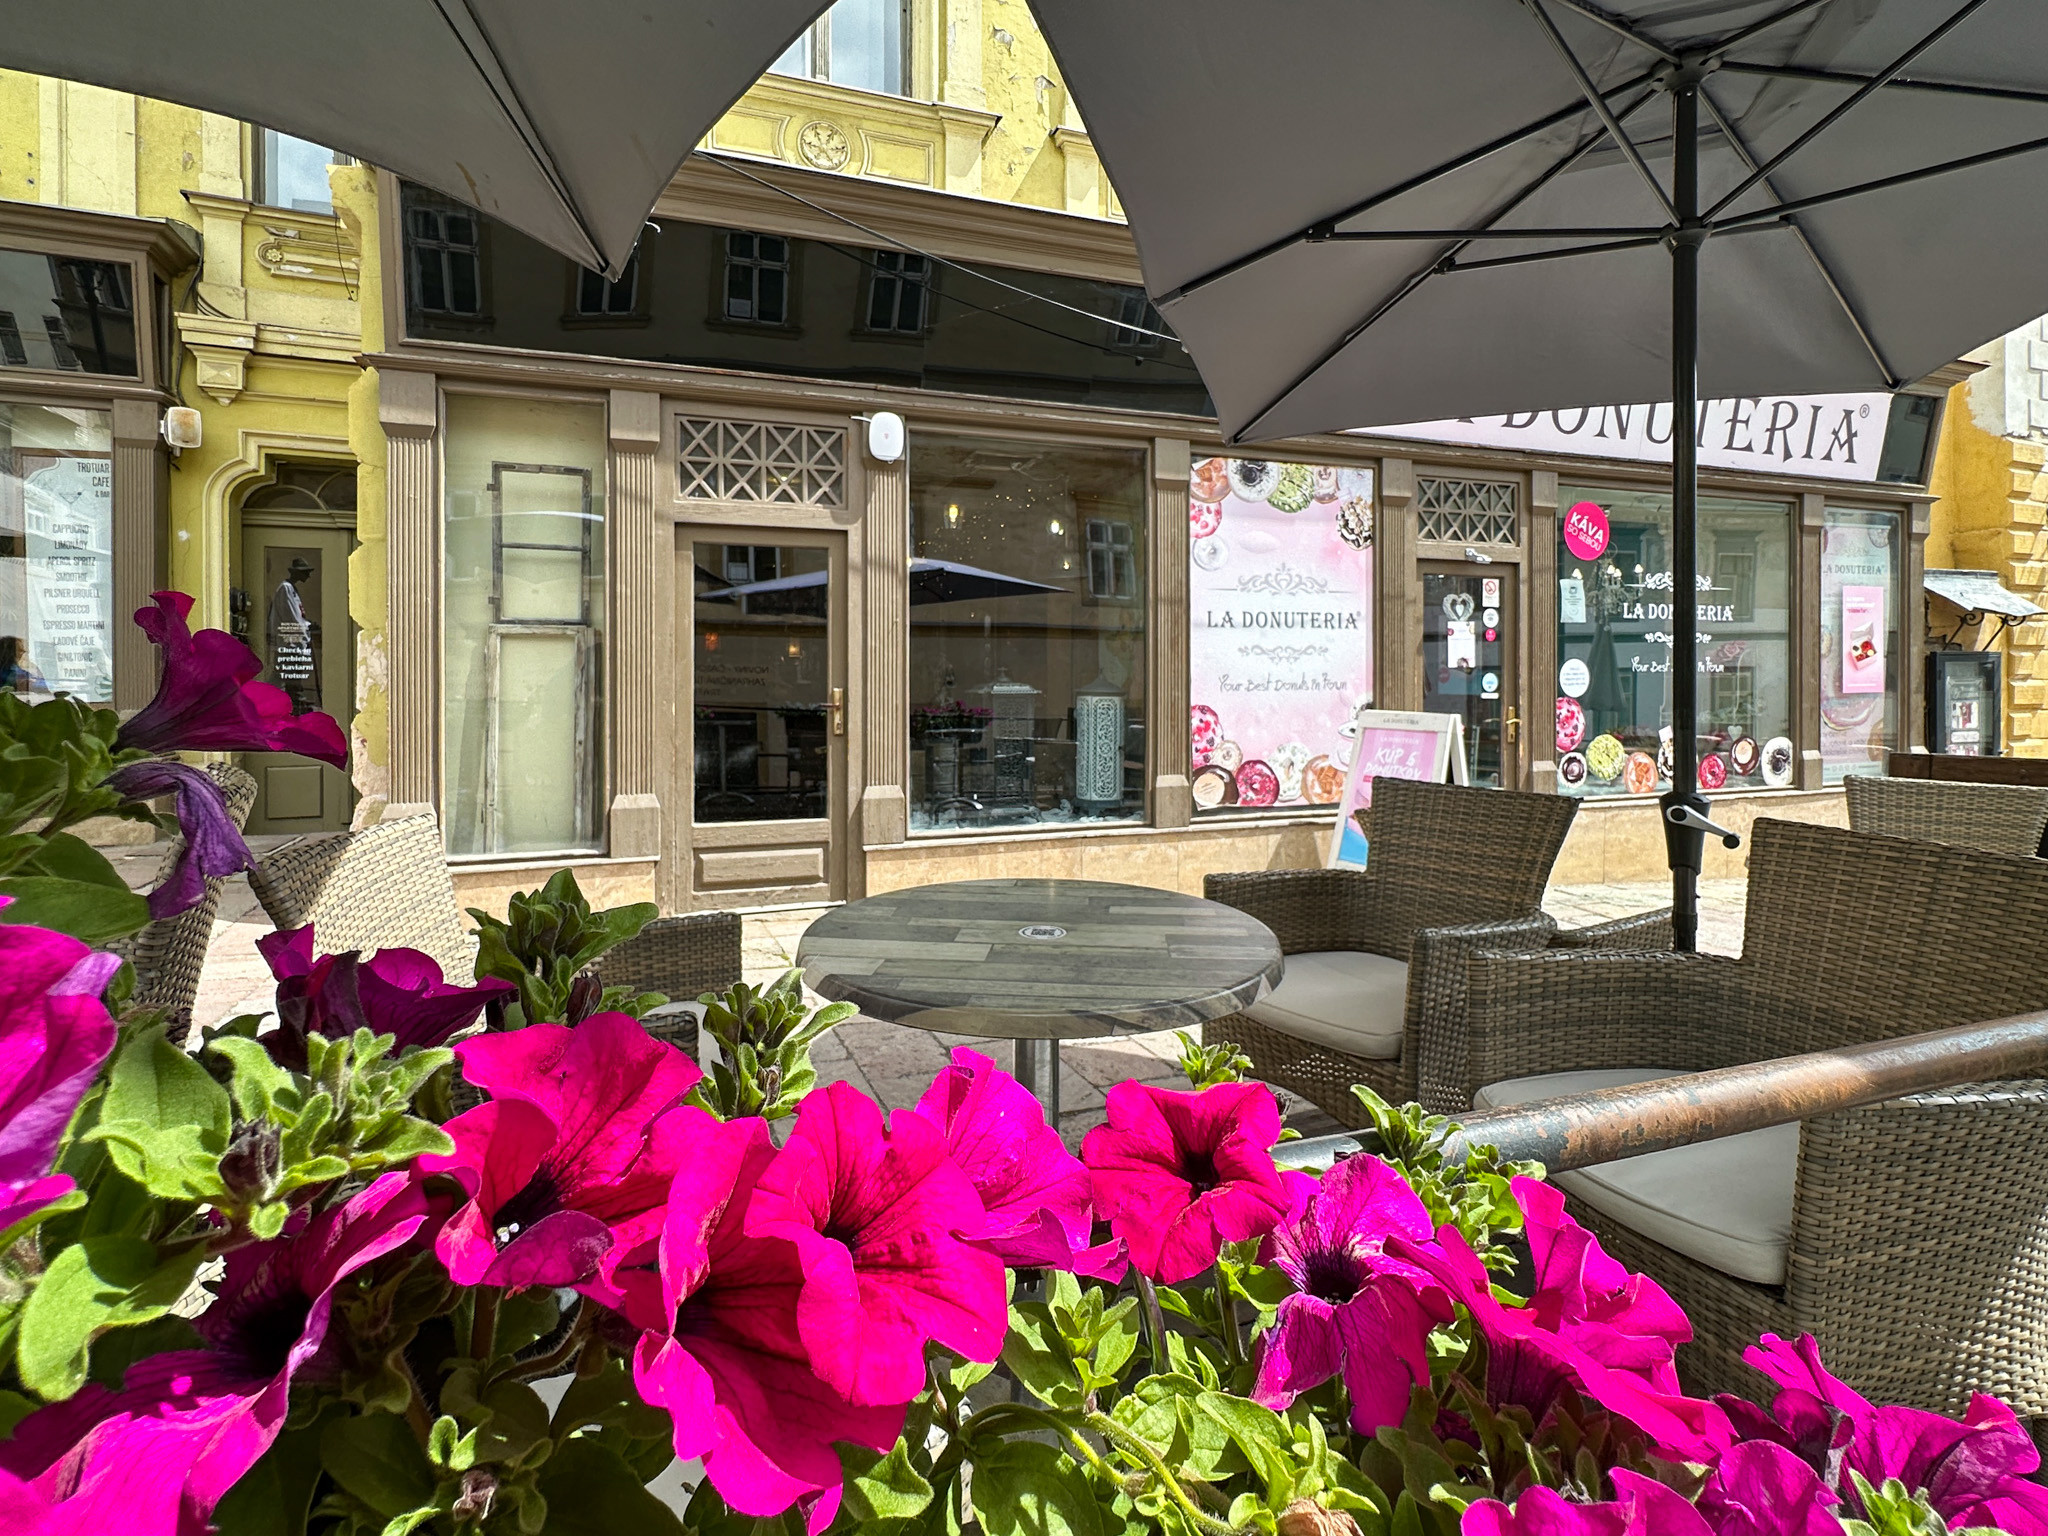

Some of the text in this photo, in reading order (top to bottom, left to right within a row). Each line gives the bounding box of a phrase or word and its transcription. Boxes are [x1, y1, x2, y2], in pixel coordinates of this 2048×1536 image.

[77, 462, 110, 473] TROTUAR
[92, 476, 110, 487] CAFE
[1570, 511, 1604, 543] KÁVA
[1567, 523, 1602, 551] SO SEBOU
[73, 556, 96, 567] SPRITZ
[1834, 564, 1882, 575] DONUTERIA
[55, 572, 88, 582] SMOOTHIE
[44, 588, 100, 598] PILSNER URQUELL
[57, 604, 90, 614] PROSECCO
[1623, 602, 1645, 619] LA
[43, 620, 76, 630] ESPRESSO
[1207, 610, 1360, 629] LA DONUTERIA
[1631, 656, 1671, 672] Your Best
[1705, 656, 1725, 673] Town
[1219, 674, 1243, 692] Your
[1245, 673, 1272, 692] Best
[1274, 672, 1310, 691] Donuts
[1321, 672, 1347, 691] Town
[1406, 751, 1420, 767] 6
